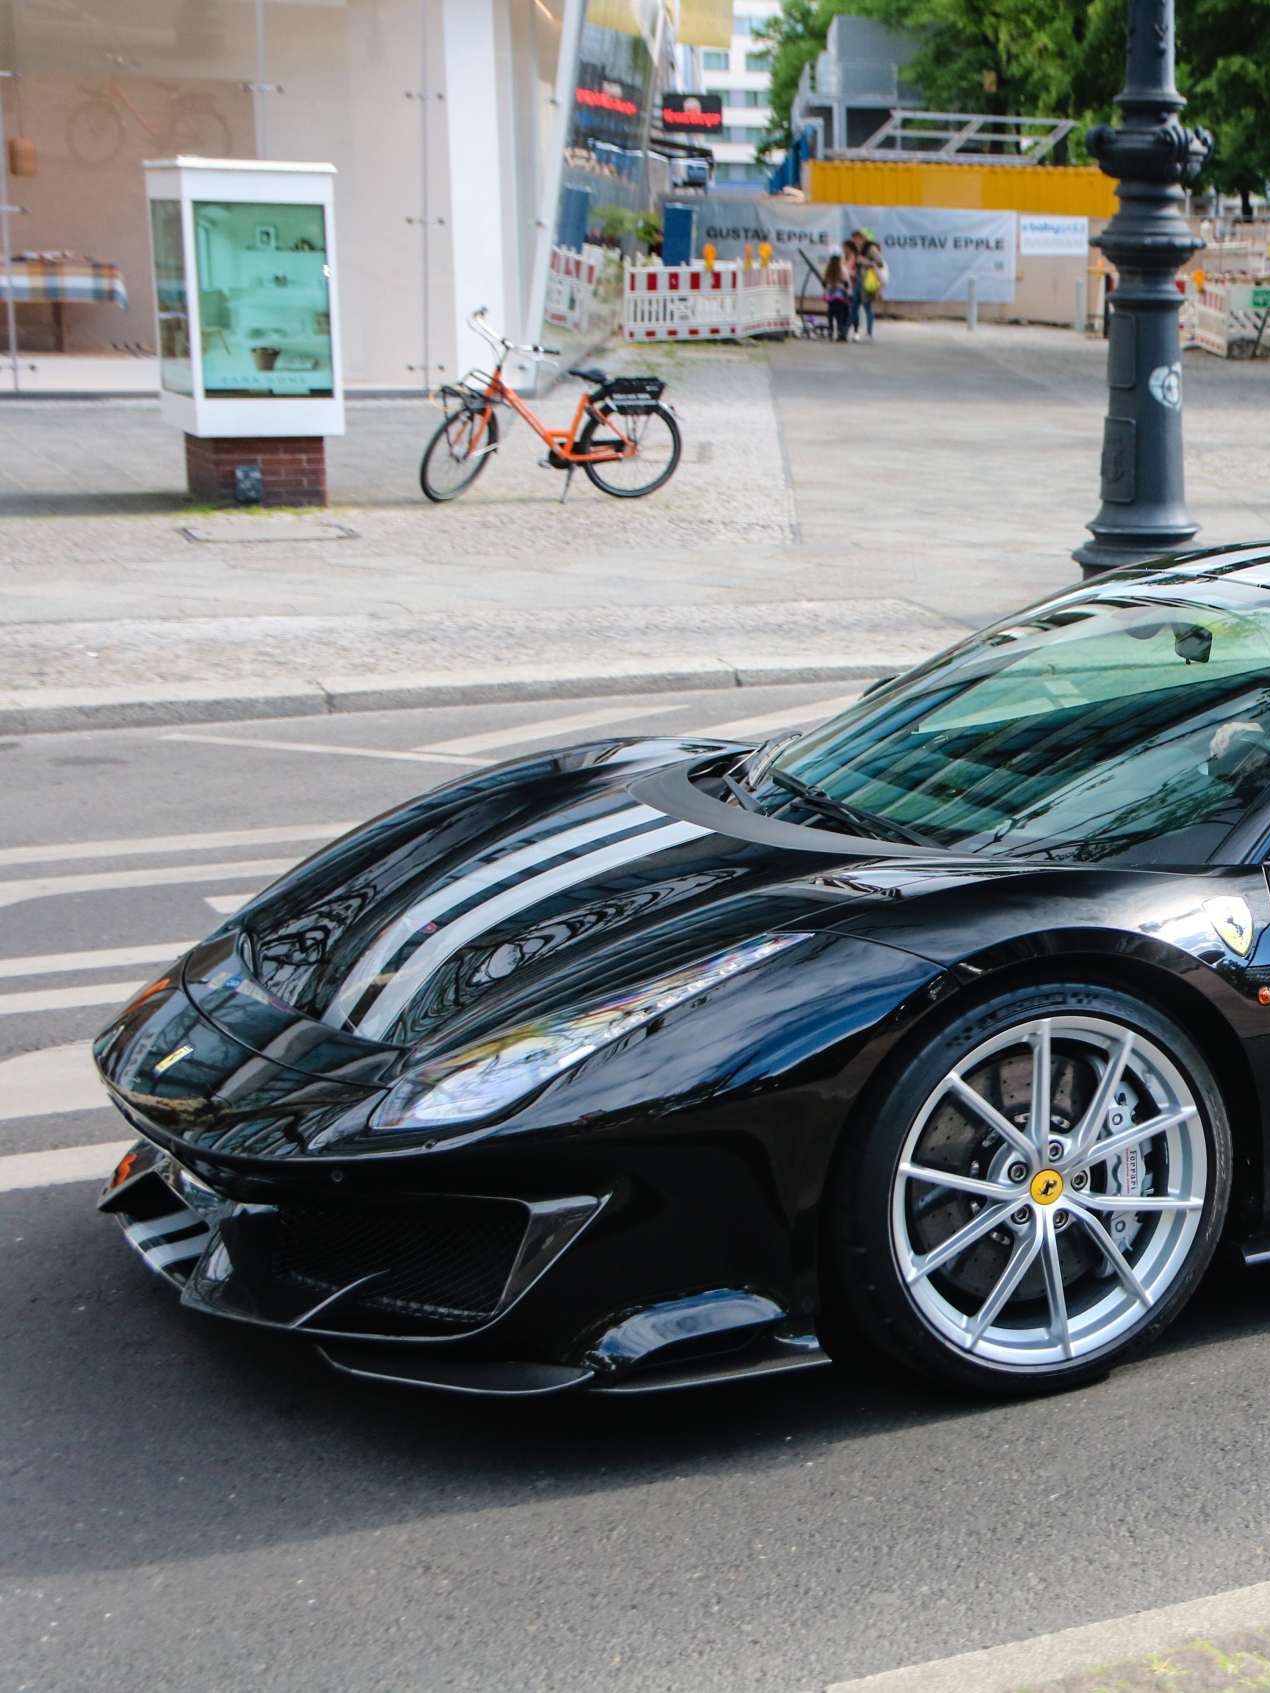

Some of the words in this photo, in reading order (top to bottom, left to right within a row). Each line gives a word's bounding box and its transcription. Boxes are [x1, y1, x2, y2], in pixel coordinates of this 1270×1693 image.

[706, 226, 769, 241] GUSTAV
[776, 229, 829, 245] EPPLE
[884, 234, 947, 249] GUSTAV
[953, 236, 1004, 250] EPPLE
[1130, 1149, 1138, 1190] Ferrari
